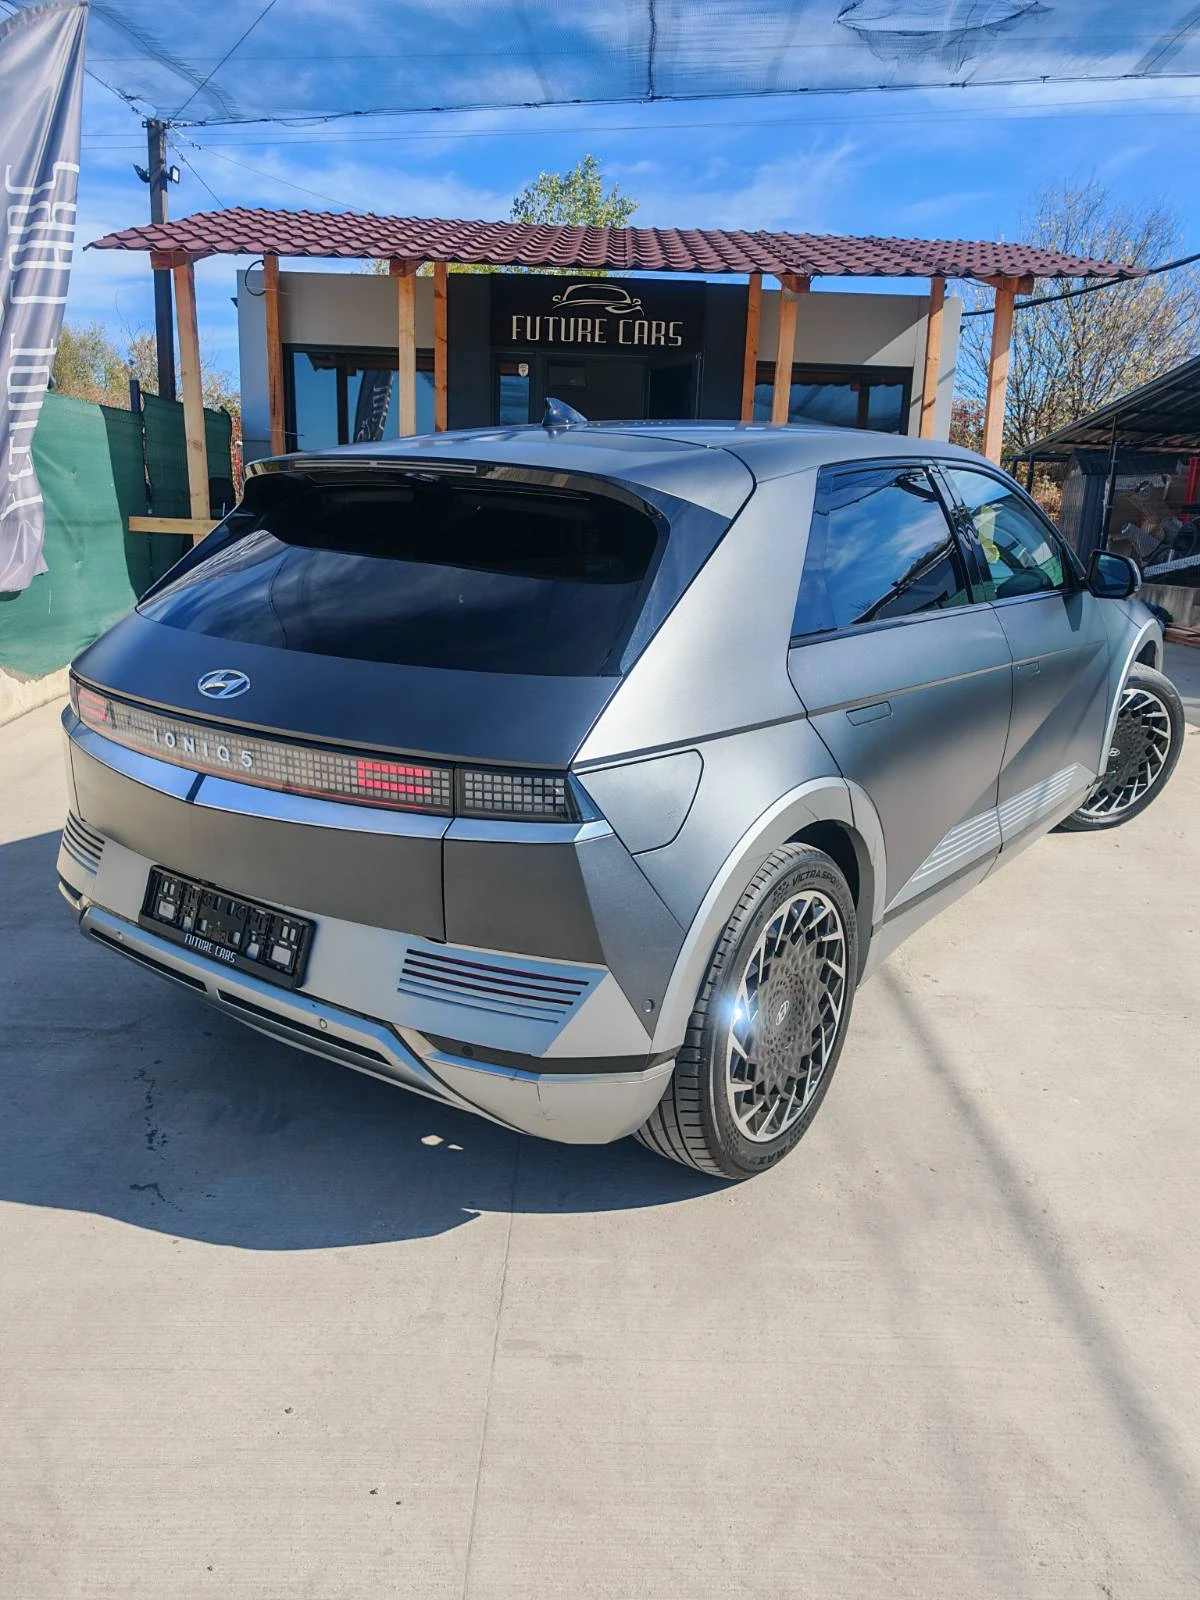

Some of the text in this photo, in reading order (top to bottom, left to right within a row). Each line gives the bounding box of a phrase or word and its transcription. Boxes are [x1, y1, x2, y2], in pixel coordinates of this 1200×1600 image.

[5, 161, 80, 304] CARS
[512, 315, 683, 346] FUTURE CARS
[153, 728, 254, 768] IONIQ 5
[184, 933, 237, 963] FUTURE CARS
